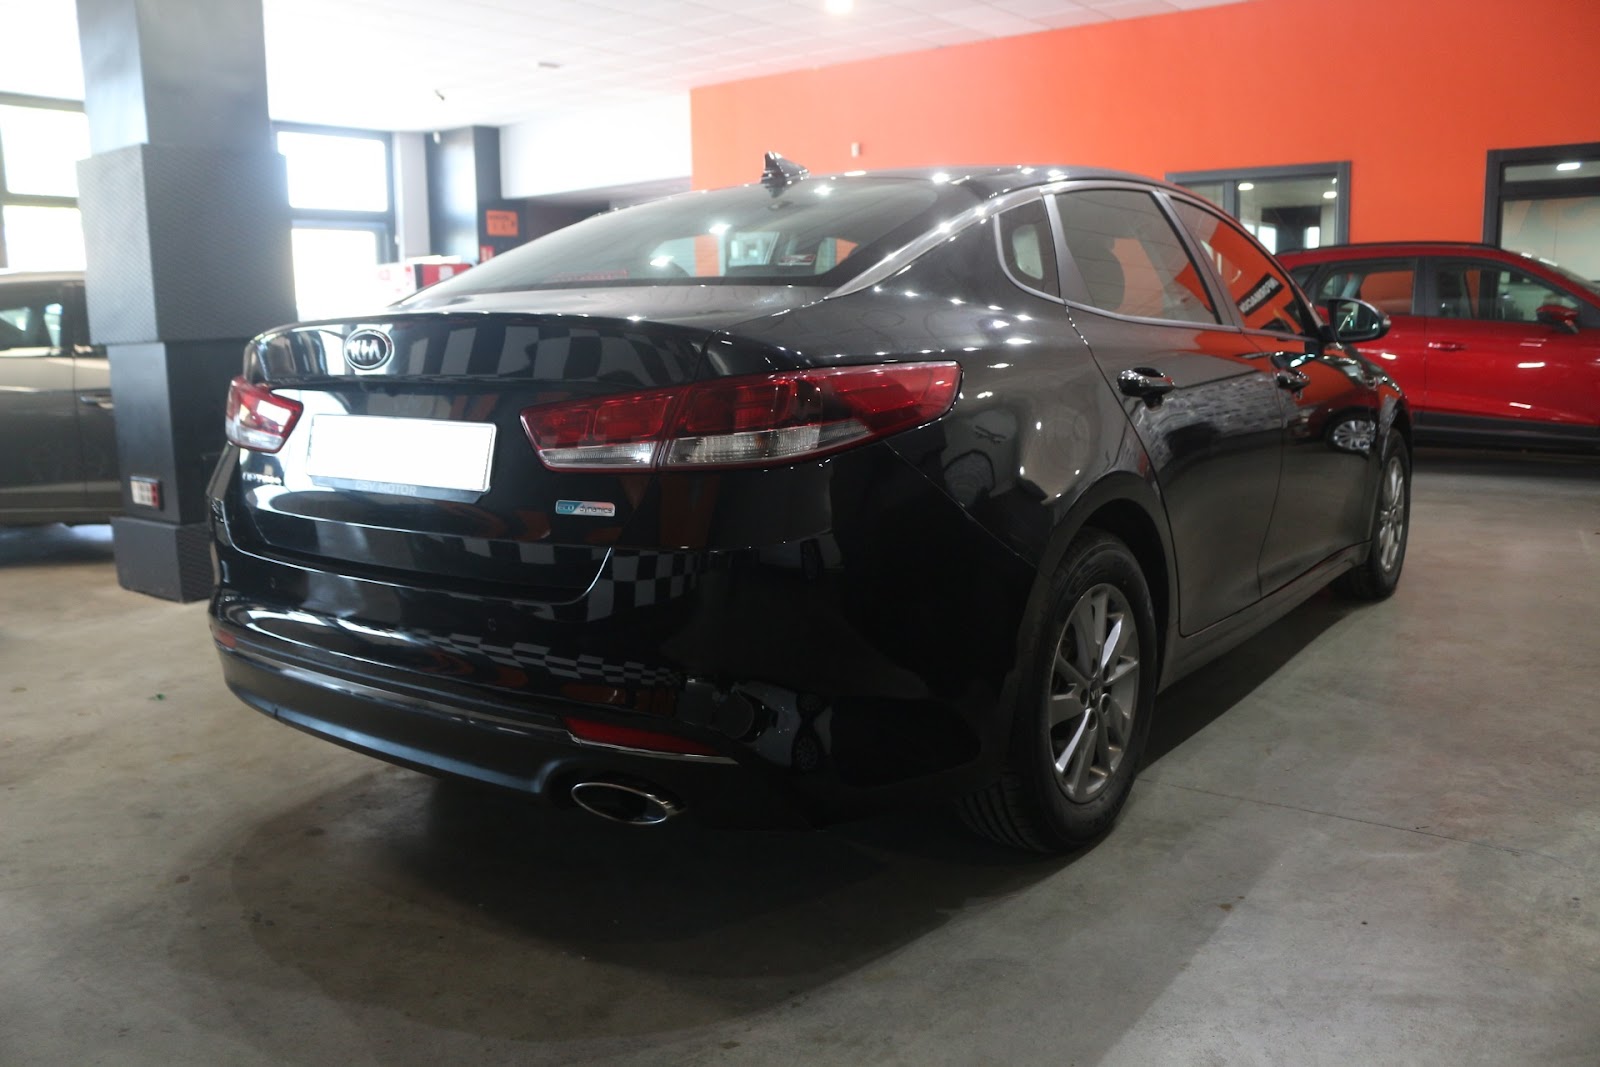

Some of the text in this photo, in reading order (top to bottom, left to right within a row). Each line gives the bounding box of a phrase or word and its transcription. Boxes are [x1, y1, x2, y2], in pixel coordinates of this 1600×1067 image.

[346, 339, 382, 361] KIA
[378, 482, 417, 496] MOTOR
[579, 504, 613, 514] dynamics
